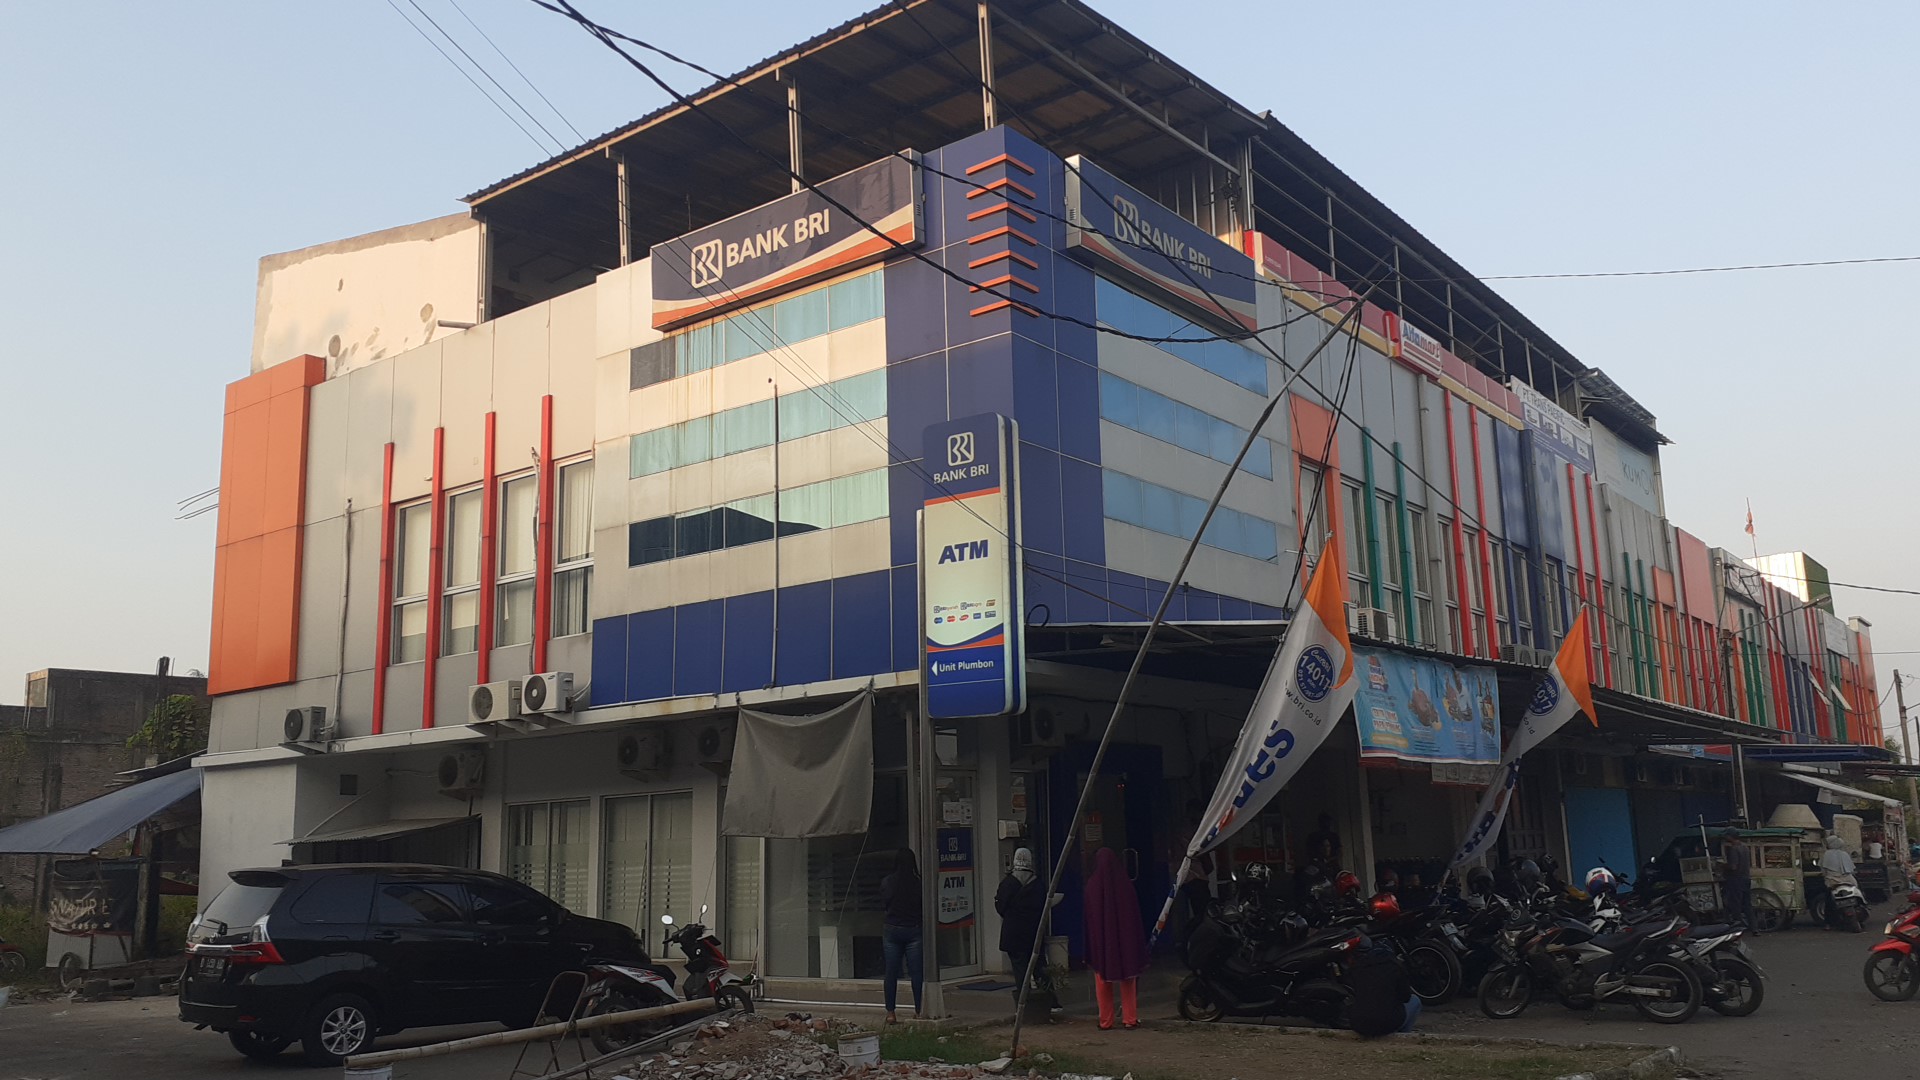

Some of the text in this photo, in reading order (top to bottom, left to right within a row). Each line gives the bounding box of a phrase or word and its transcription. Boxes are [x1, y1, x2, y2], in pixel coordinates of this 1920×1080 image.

[727, 208, 830, 268] BANK BRI
[1141, 219, 1212, 279] BANK BRI
[1403, 322, 1440, 358] Alfamart
[933, 464, 990, 484] BANK BRI
[938, 539, 989, 565] ATM
[939, 658, 994, 673] Unit Plumbon
[1300, 655, 1331, 690] 14017
[940, 852, 967, 862] BANK BRI
[943, 876, 965, 889] ATM
